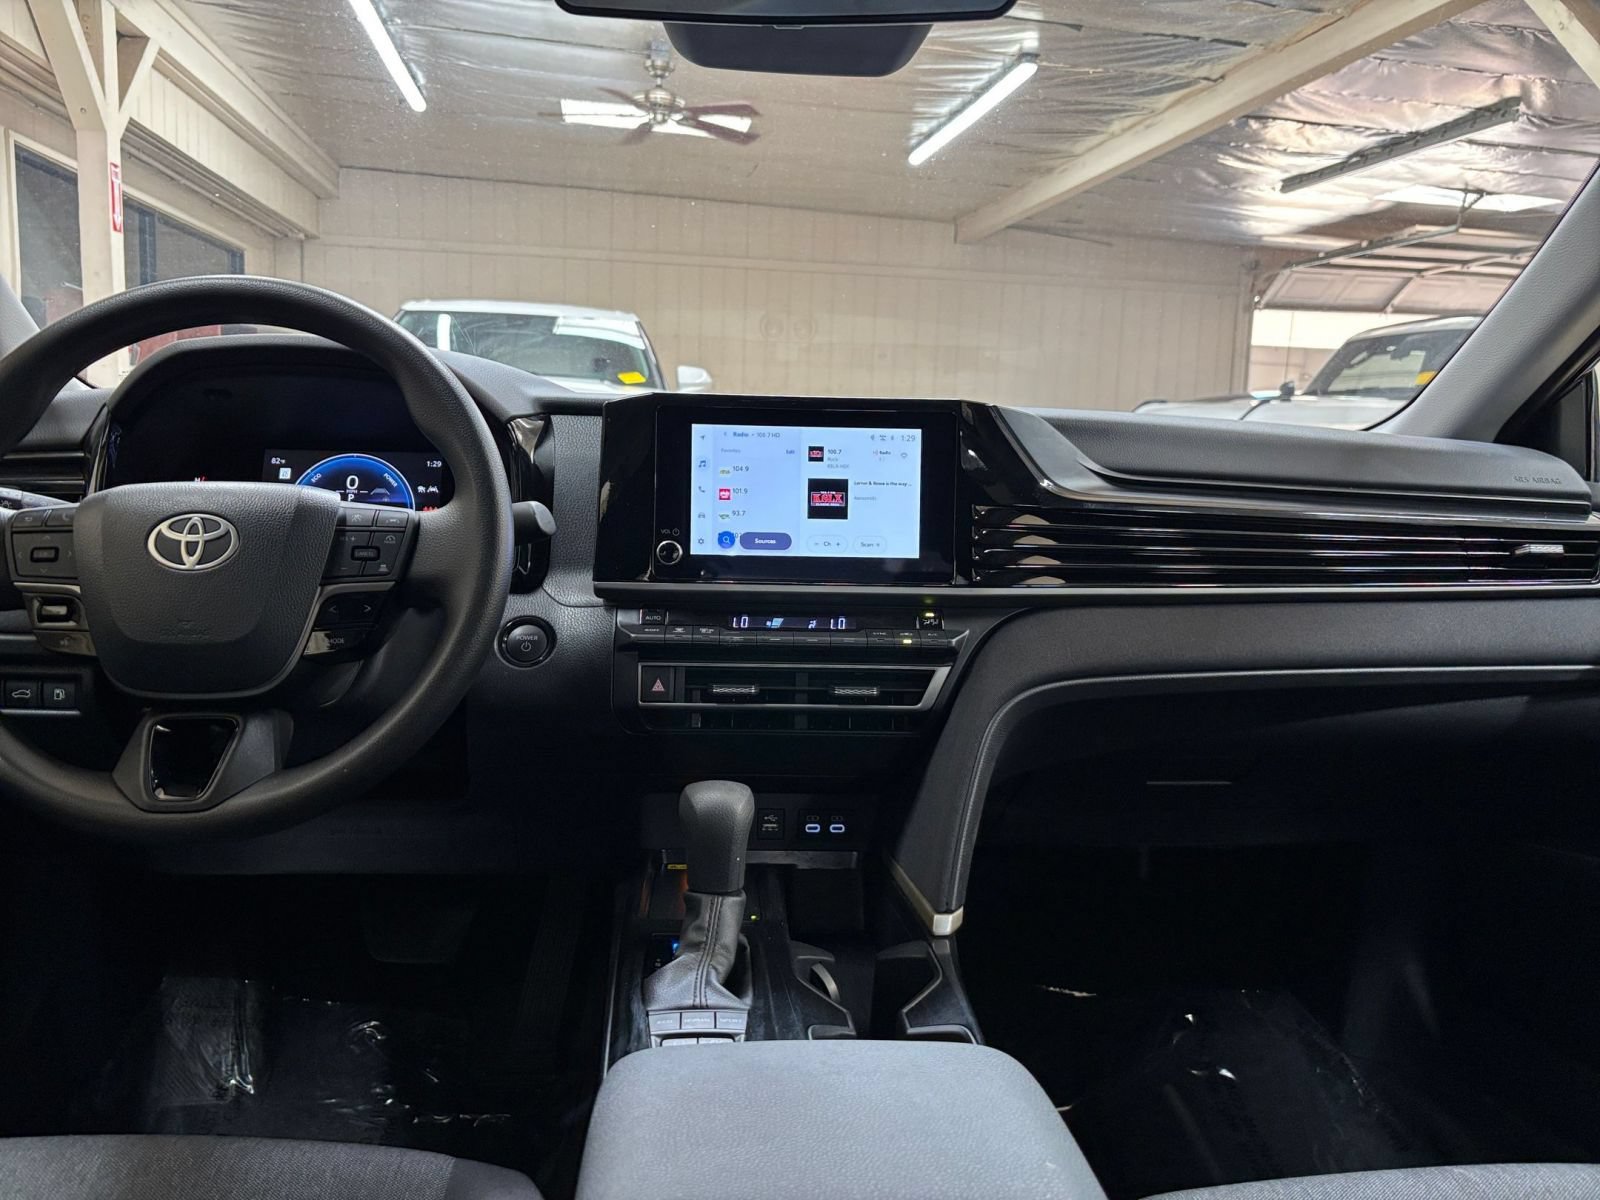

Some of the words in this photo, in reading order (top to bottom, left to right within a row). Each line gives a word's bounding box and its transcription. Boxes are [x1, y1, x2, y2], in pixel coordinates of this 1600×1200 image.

[901, 434, 916, 442] 1:29
[426, 460, 442, 468] 1:29
[311, 473, 322, 484] ECO
[346, 475, 359, 490] 0
[383, 472, 399, 487] POWER
[348, 493, 355, 502] P
